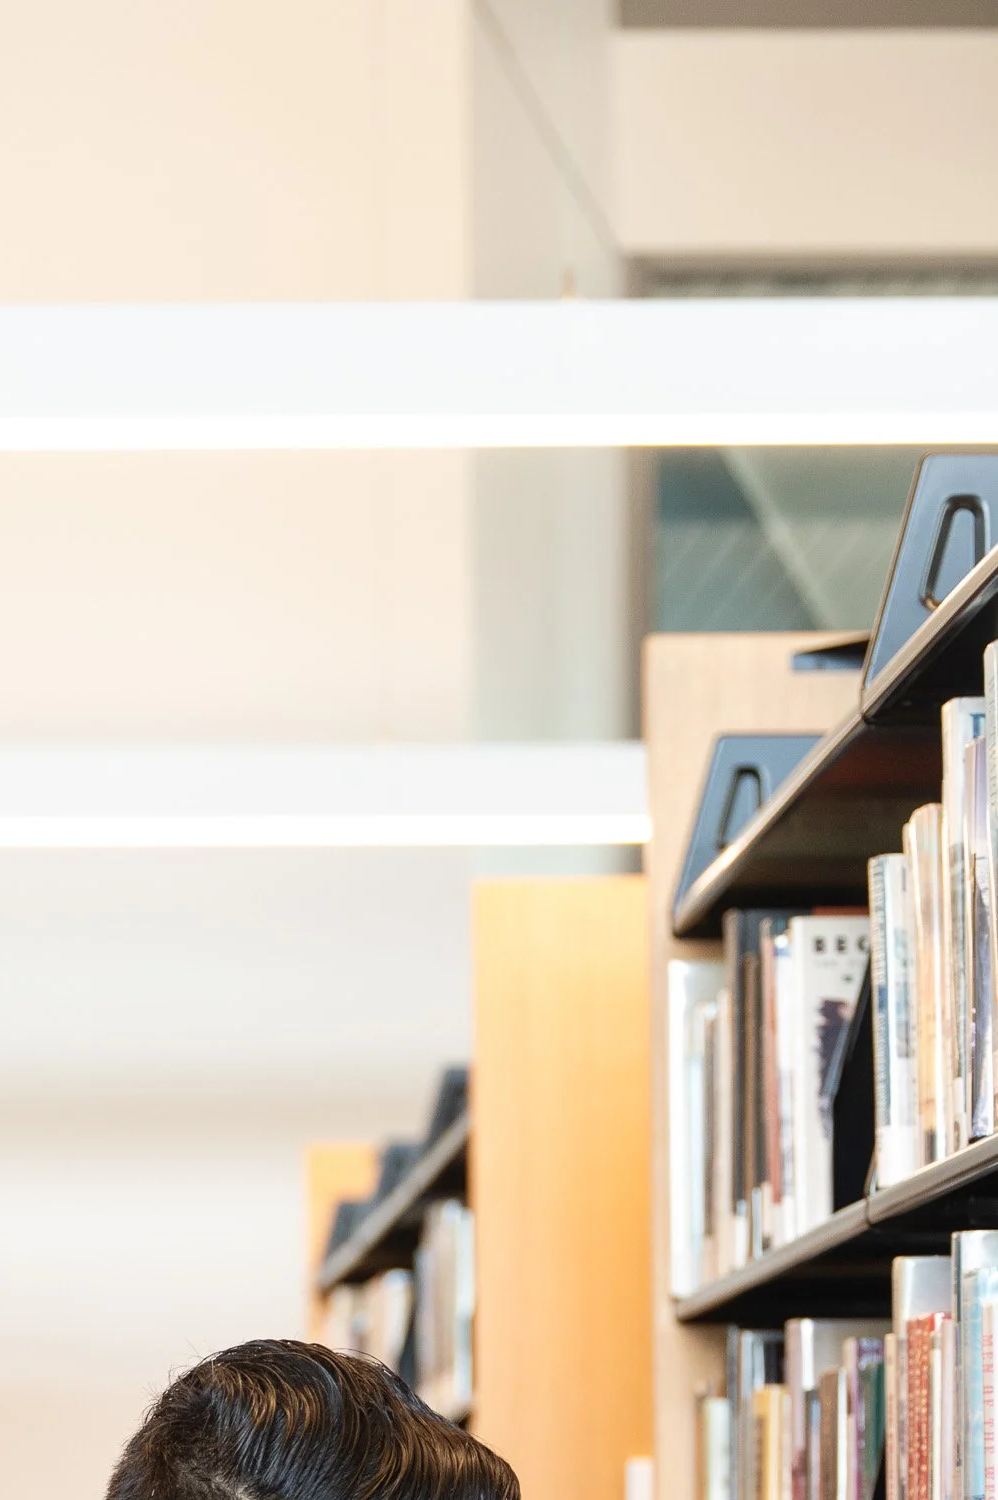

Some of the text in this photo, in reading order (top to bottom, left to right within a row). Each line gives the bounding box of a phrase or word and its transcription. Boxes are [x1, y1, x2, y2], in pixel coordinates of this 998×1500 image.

[982, 1334, 994, 1374] MEN
[983, 1385, 995, 1407] OF
[984, 1418, 995, 1454] THE
